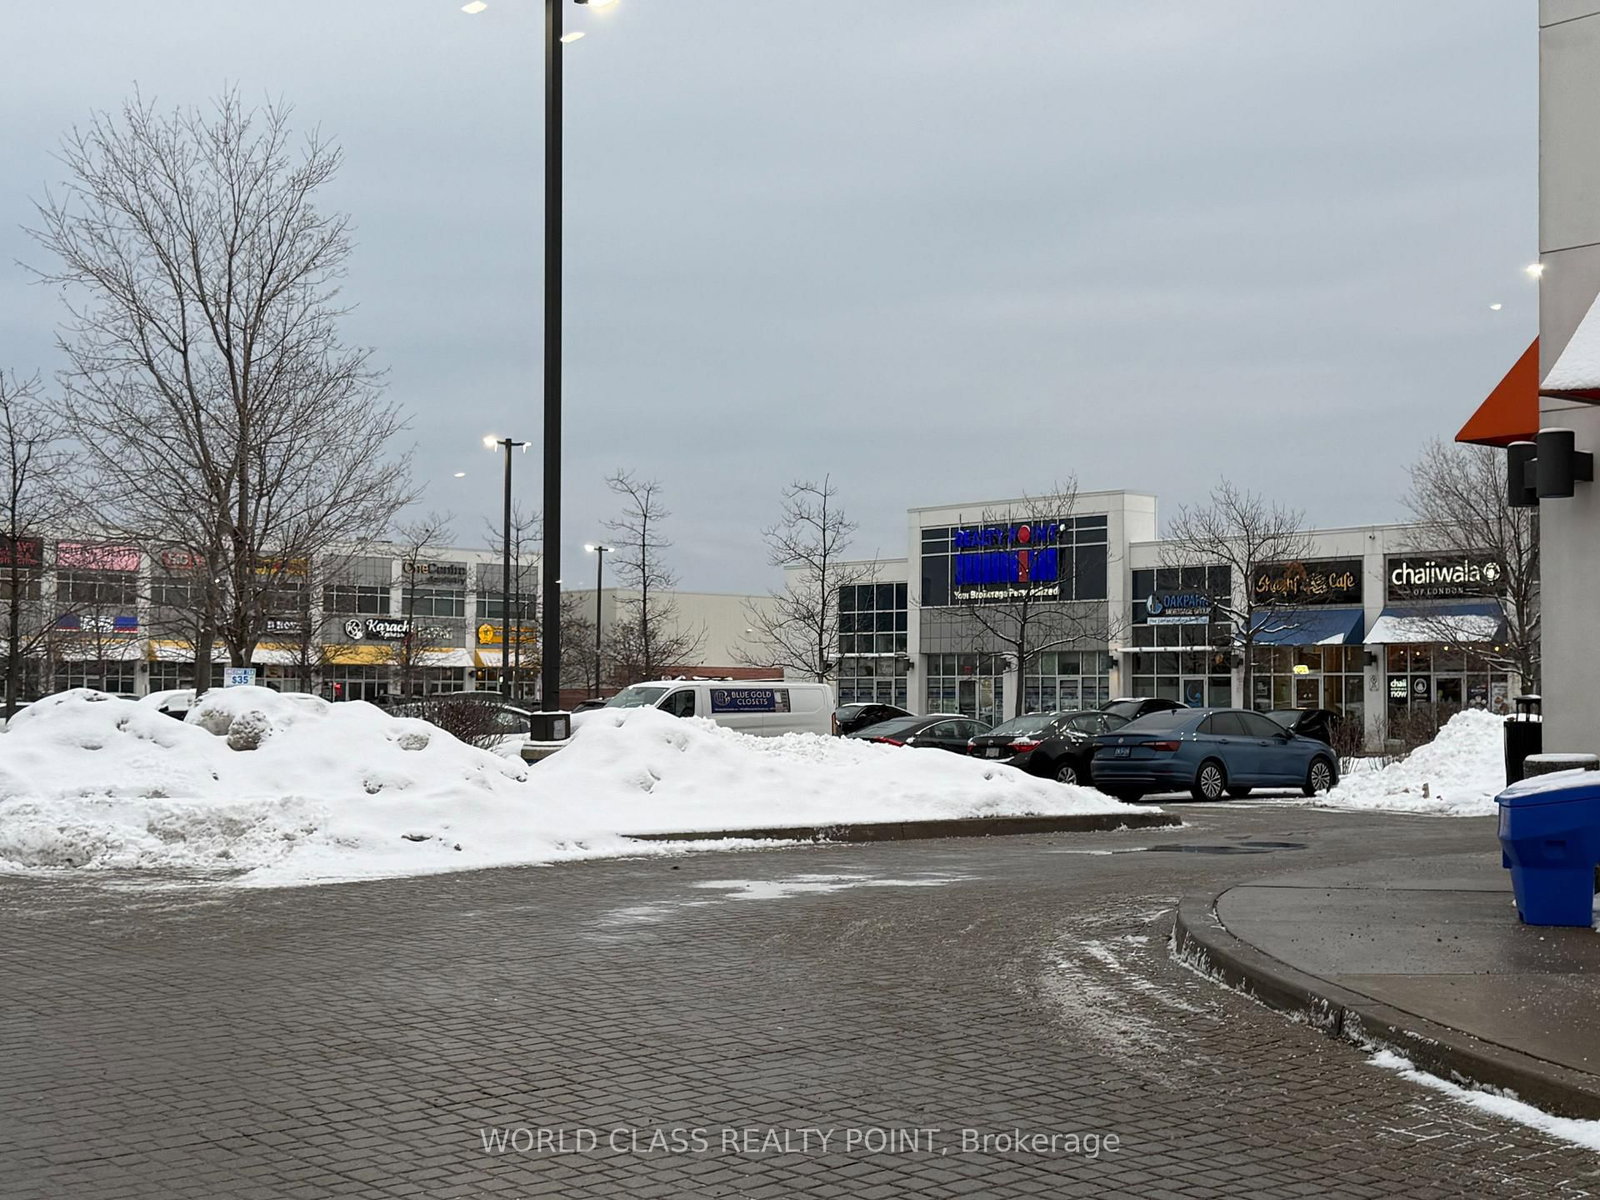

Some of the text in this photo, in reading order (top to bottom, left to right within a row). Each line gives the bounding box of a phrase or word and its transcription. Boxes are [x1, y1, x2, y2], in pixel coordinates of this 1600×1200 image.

[1391, 560, 1480, 585] chaiiwala
[1328, 572, 1356, 592] Cafe
[954, 591, 970, 600] Your
[1413, 587, 1464, 596] OF LONDON
[366, 618, 415, 633] Karachi
[232, 675, 249, 684] $35
[731, 690, 772, 699] BLUE GOLD
[736, 698, 768, 706] CLOSETS
